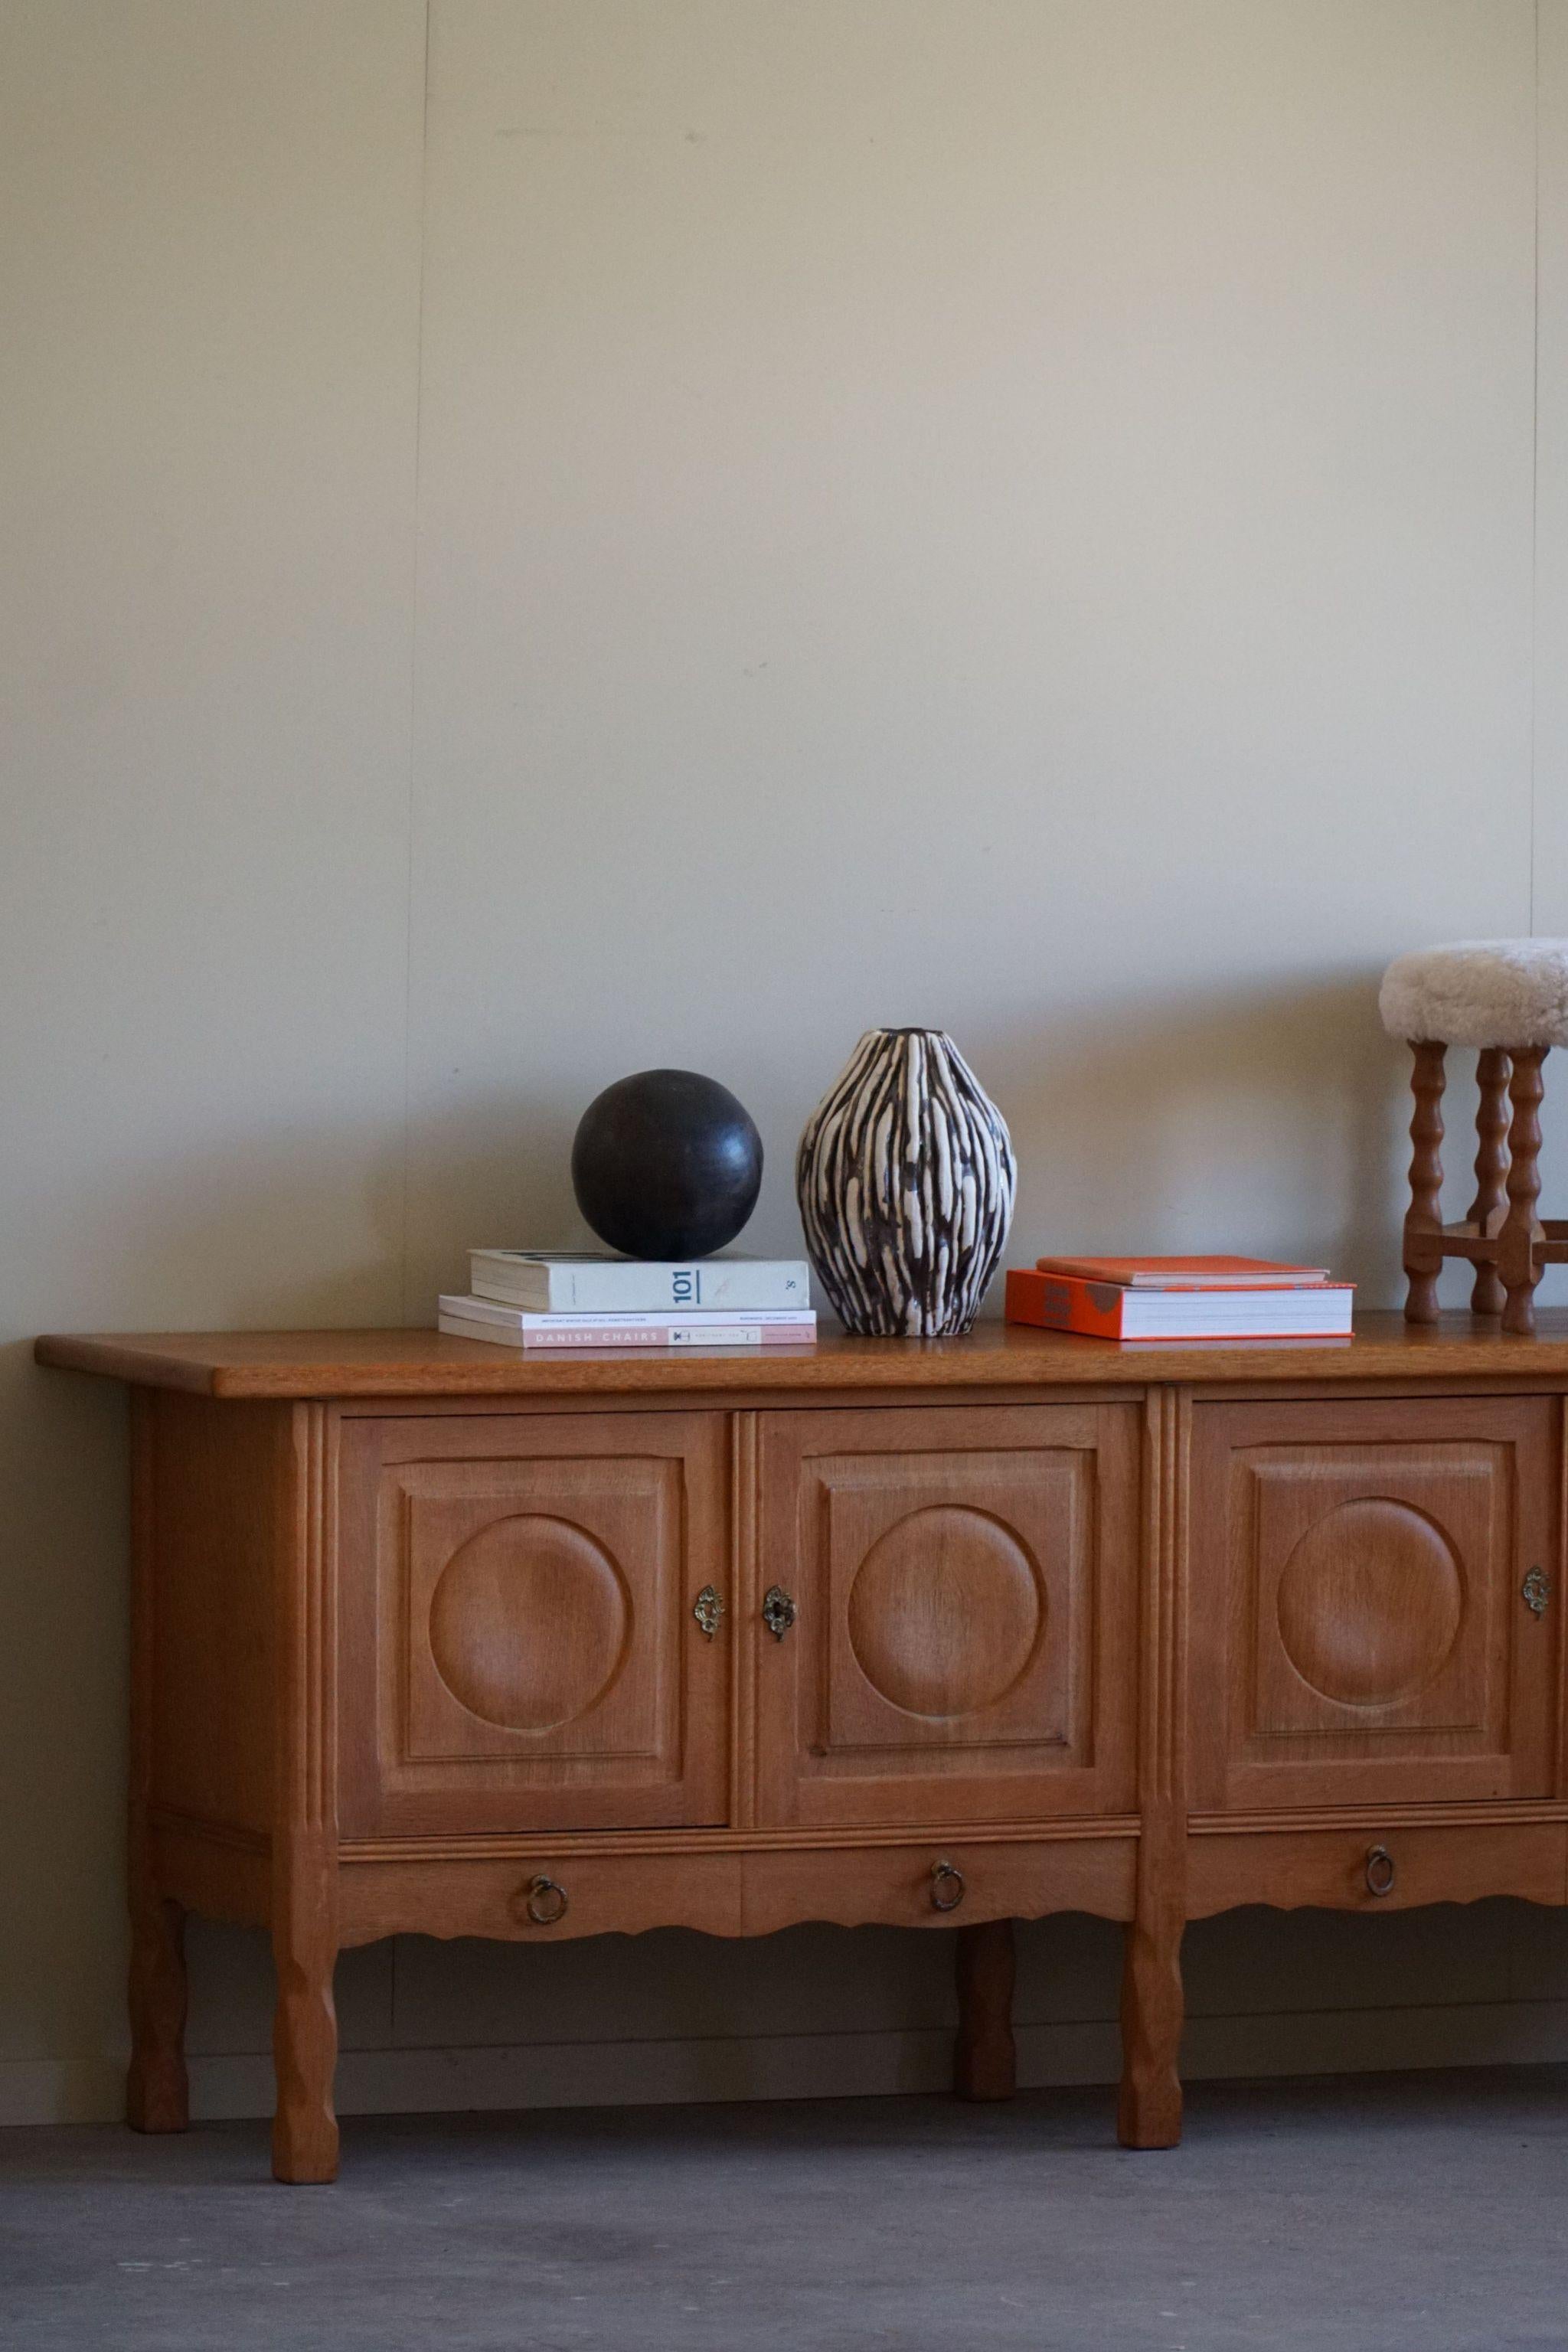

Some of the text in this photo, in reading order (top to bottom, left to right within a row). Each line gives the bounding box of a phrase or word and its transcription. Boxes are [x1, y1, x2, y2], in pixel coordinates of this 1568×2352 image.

[672, 1271, 691, 1304] 101
[536, 1332, 657, 1342] DANISH CHAIRS
